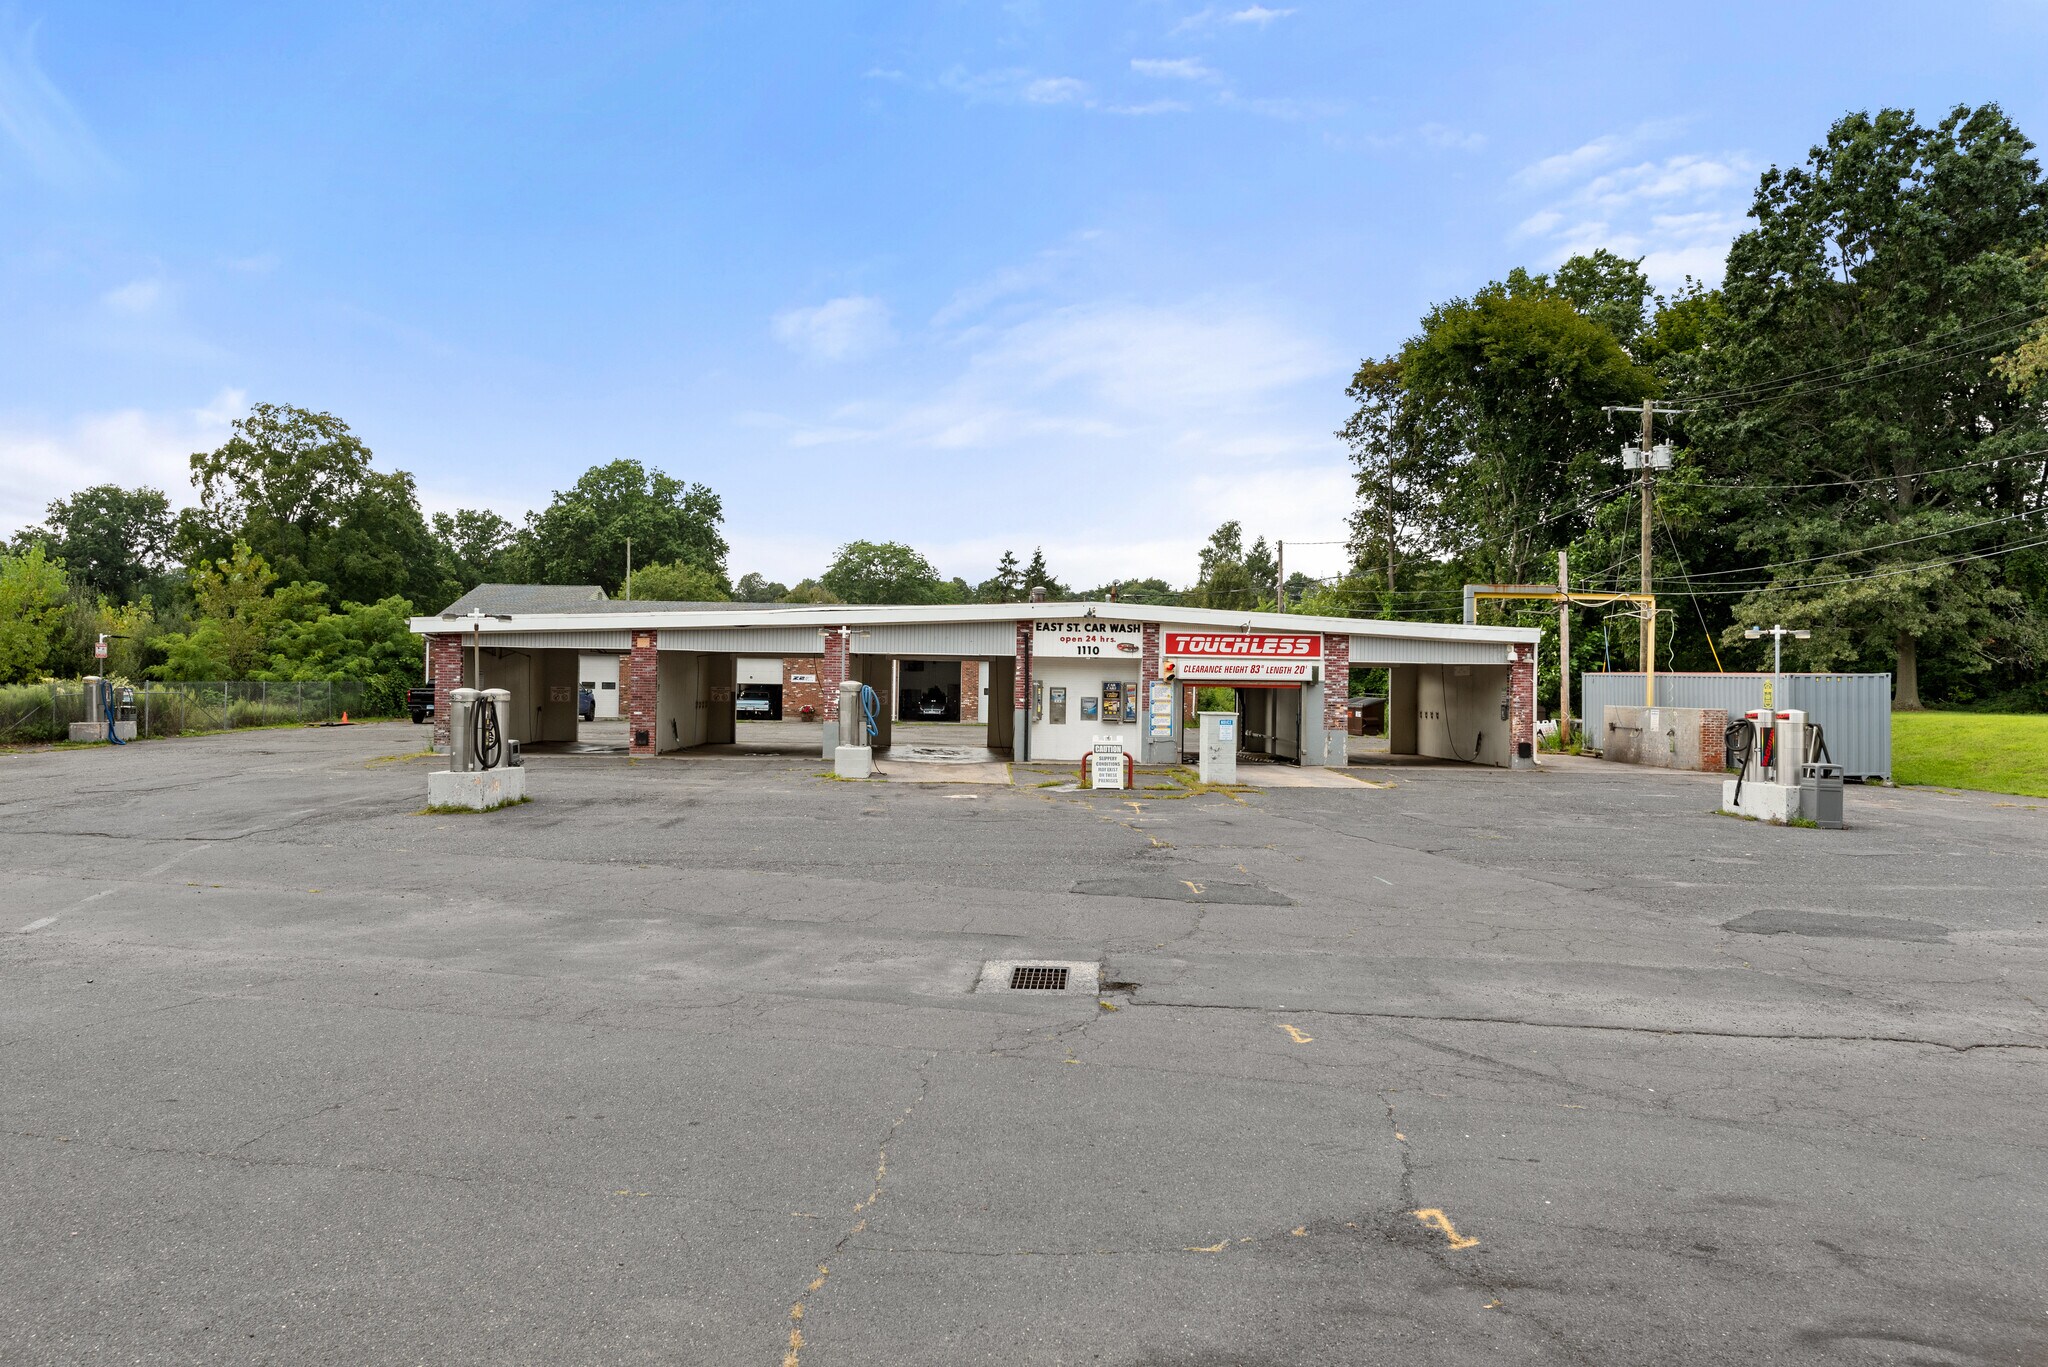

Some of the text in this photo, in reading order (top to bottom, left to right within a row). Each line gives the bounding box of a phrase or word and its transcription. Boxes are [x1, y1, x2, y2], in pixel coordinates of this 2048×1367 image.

[1036, 623, 1140, 633] EAST ST. CAR WASH
[1060, 635, 1082, 643] open
[1175, 636, 1311, 654] TOUCHLESS
[1077, 646, 1099, 655] 1110
[1184, 665, 1222, 674] CLEARANCE
[1224, 665, 1248, 674] HEIGHT
[1266, 667, 1292, 675] LENGTH
